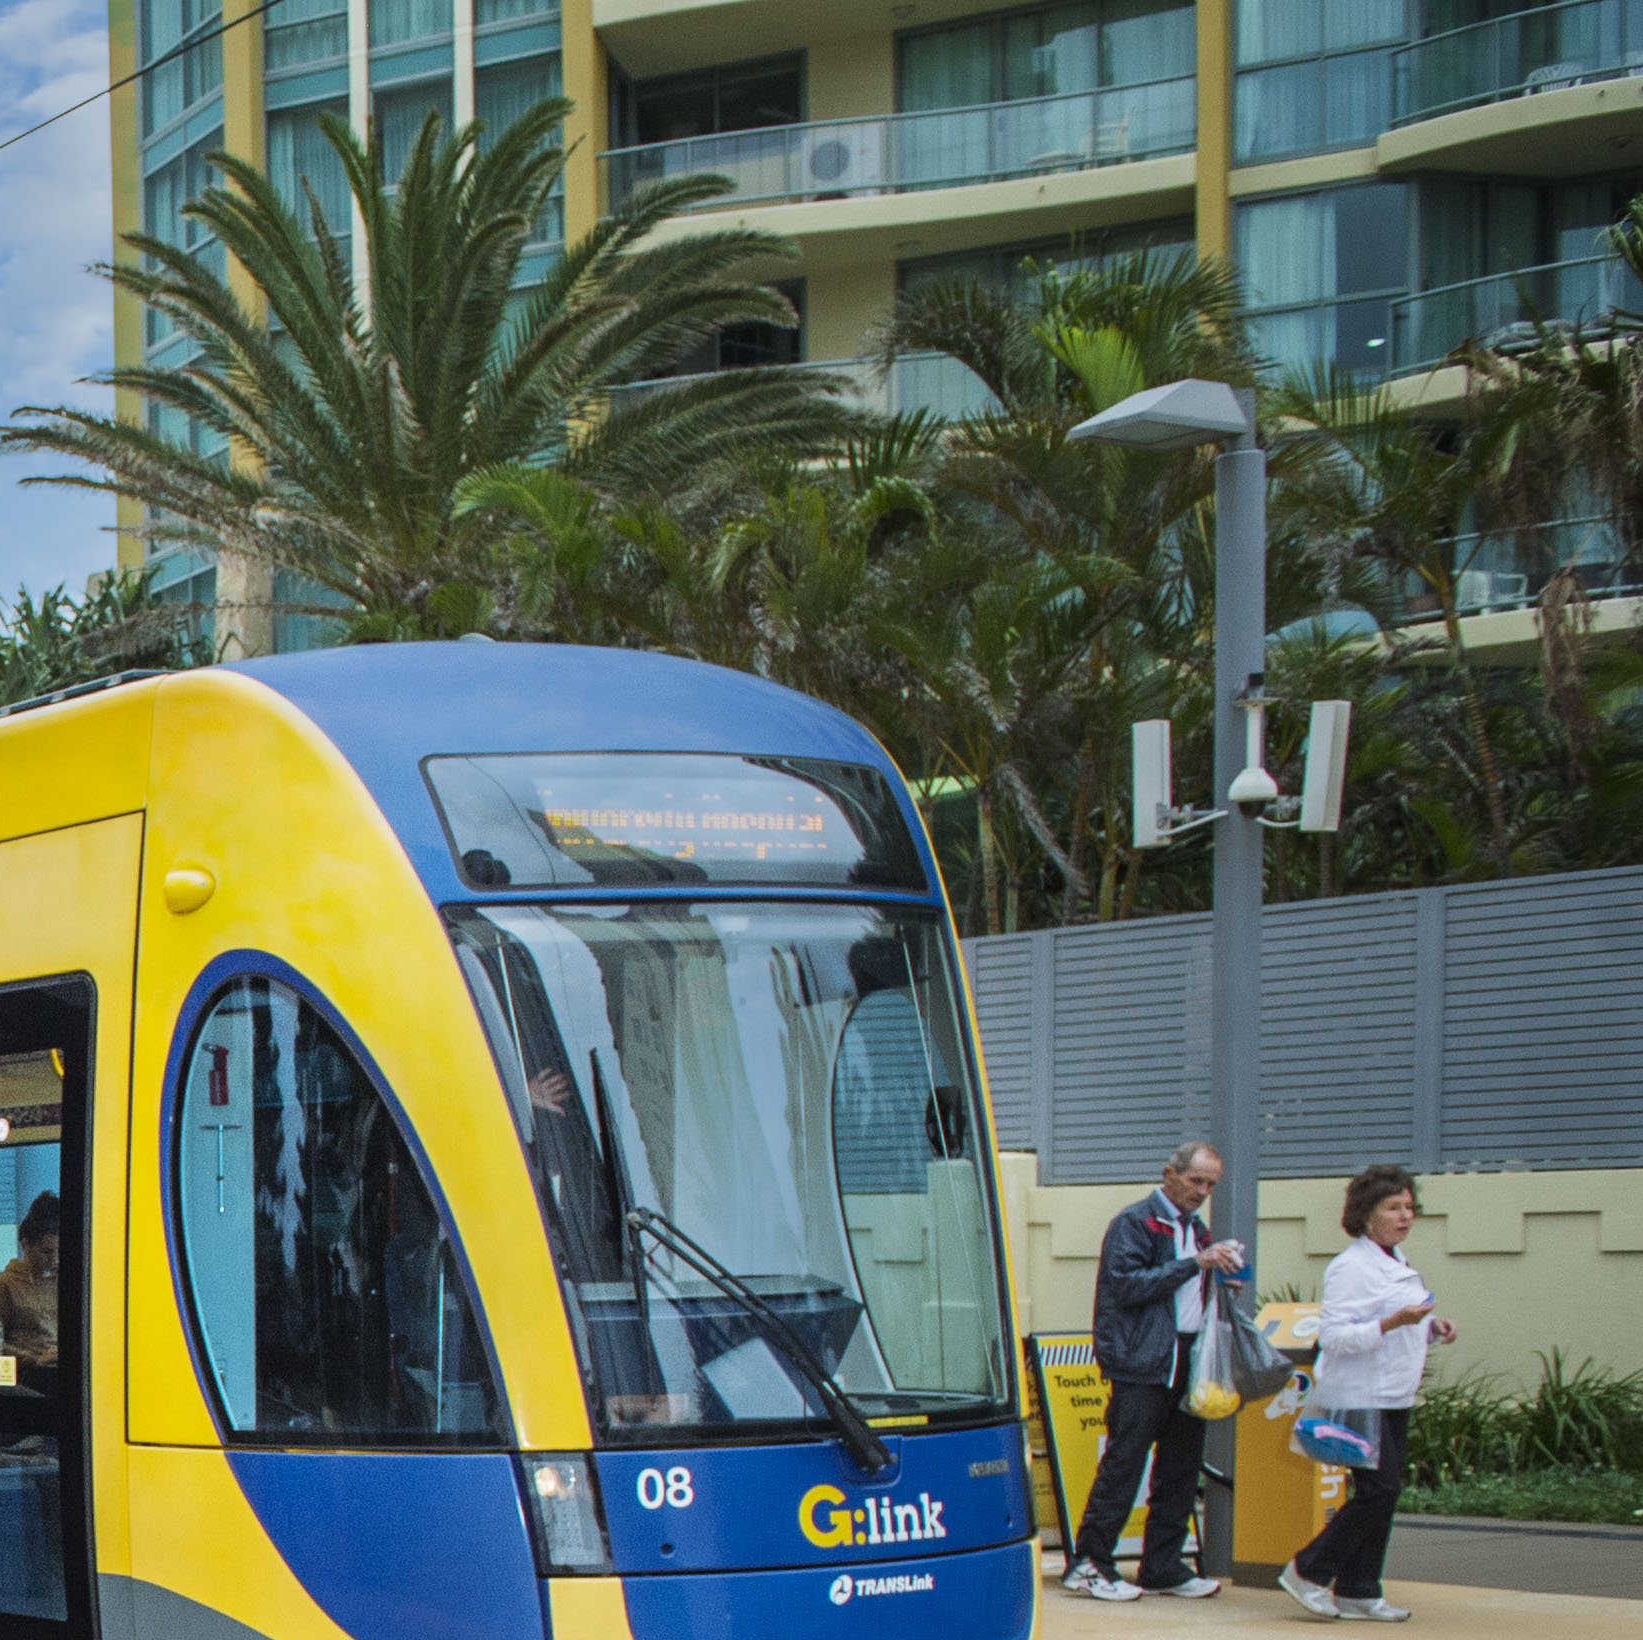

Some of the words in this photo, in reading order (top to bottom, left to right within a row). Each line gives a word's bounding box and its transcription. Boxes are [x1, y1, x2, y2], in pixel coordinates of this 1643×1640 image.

[1054, 1374, 1097, 1388] Touch
[1070, 1394, 1102, 1408] time
[636, 1466, 694, 1510] 08
[798, 1484, 947, 1548] G:link
[855, 1573, 935, 1597] TRANSLink
